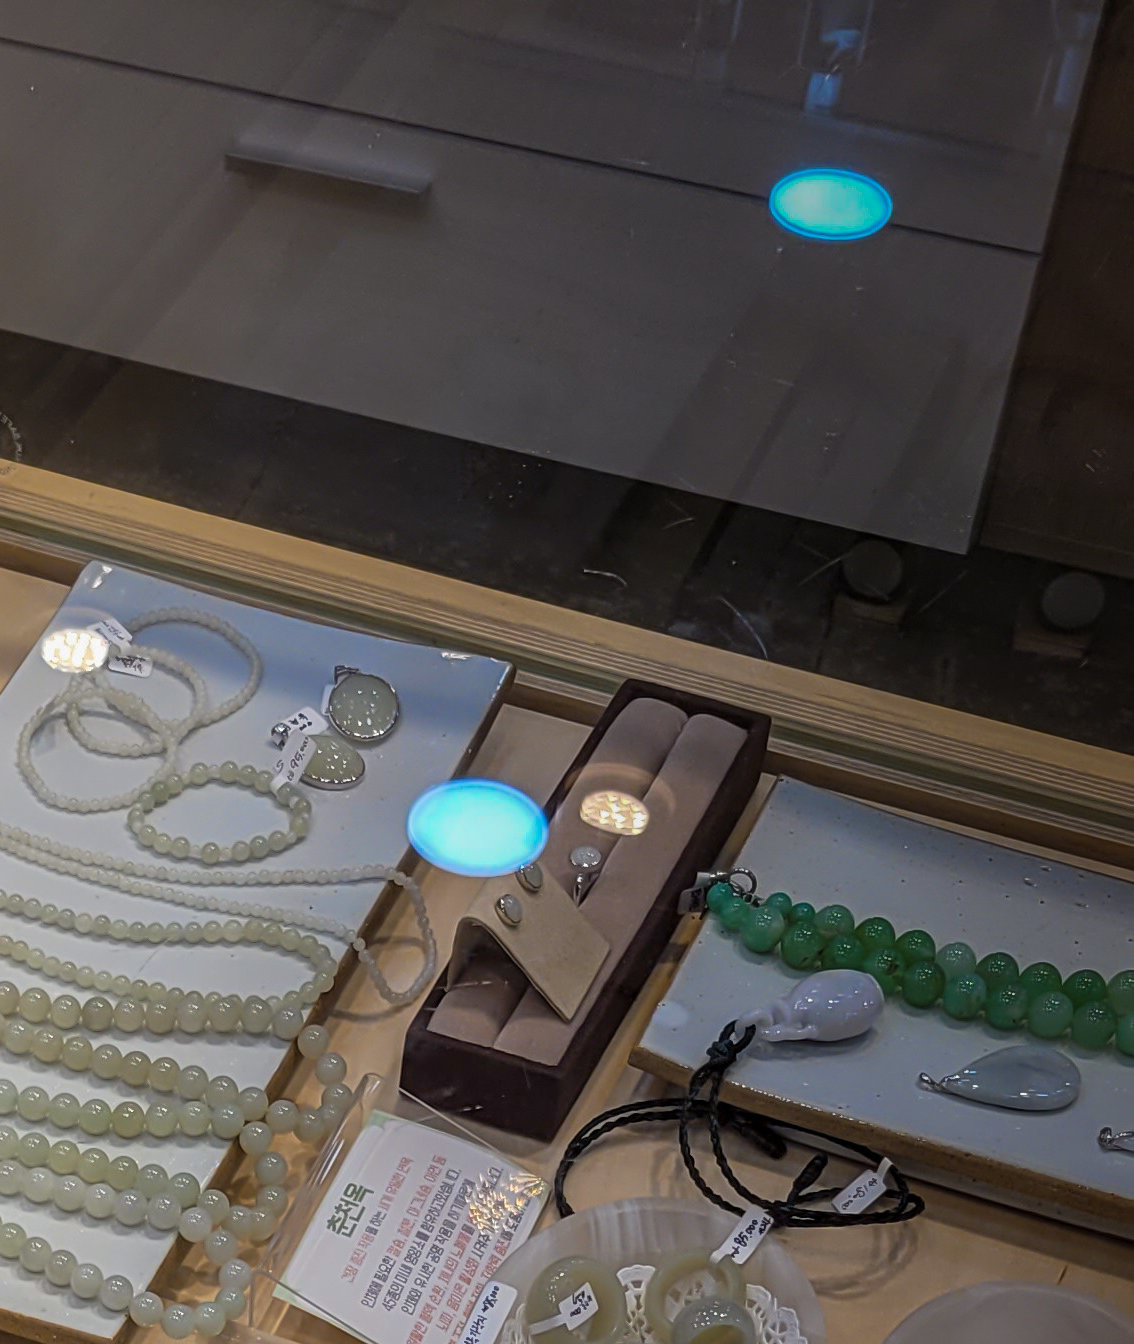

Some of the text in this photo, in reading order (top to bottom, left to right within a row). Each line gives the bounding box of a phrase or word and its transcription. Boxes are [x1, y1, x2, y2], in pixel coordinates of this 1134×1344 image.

[326, 1182, 375, 1238] 춘천옥
[433, 1218, 457, 1245] 작용을
[425, 1243, 445, 1264] 공명
[360, 1280, 384, 1309] 인체에
[373, 1255, 397, 1283] 필요한
[381, 1280, 405, 1312] 45종의
[403, 1230, 431, 1266] 영양소를
[413, 1261, 436, 1289] 유사한
[400, 1287, 423, 1316] 인체와
